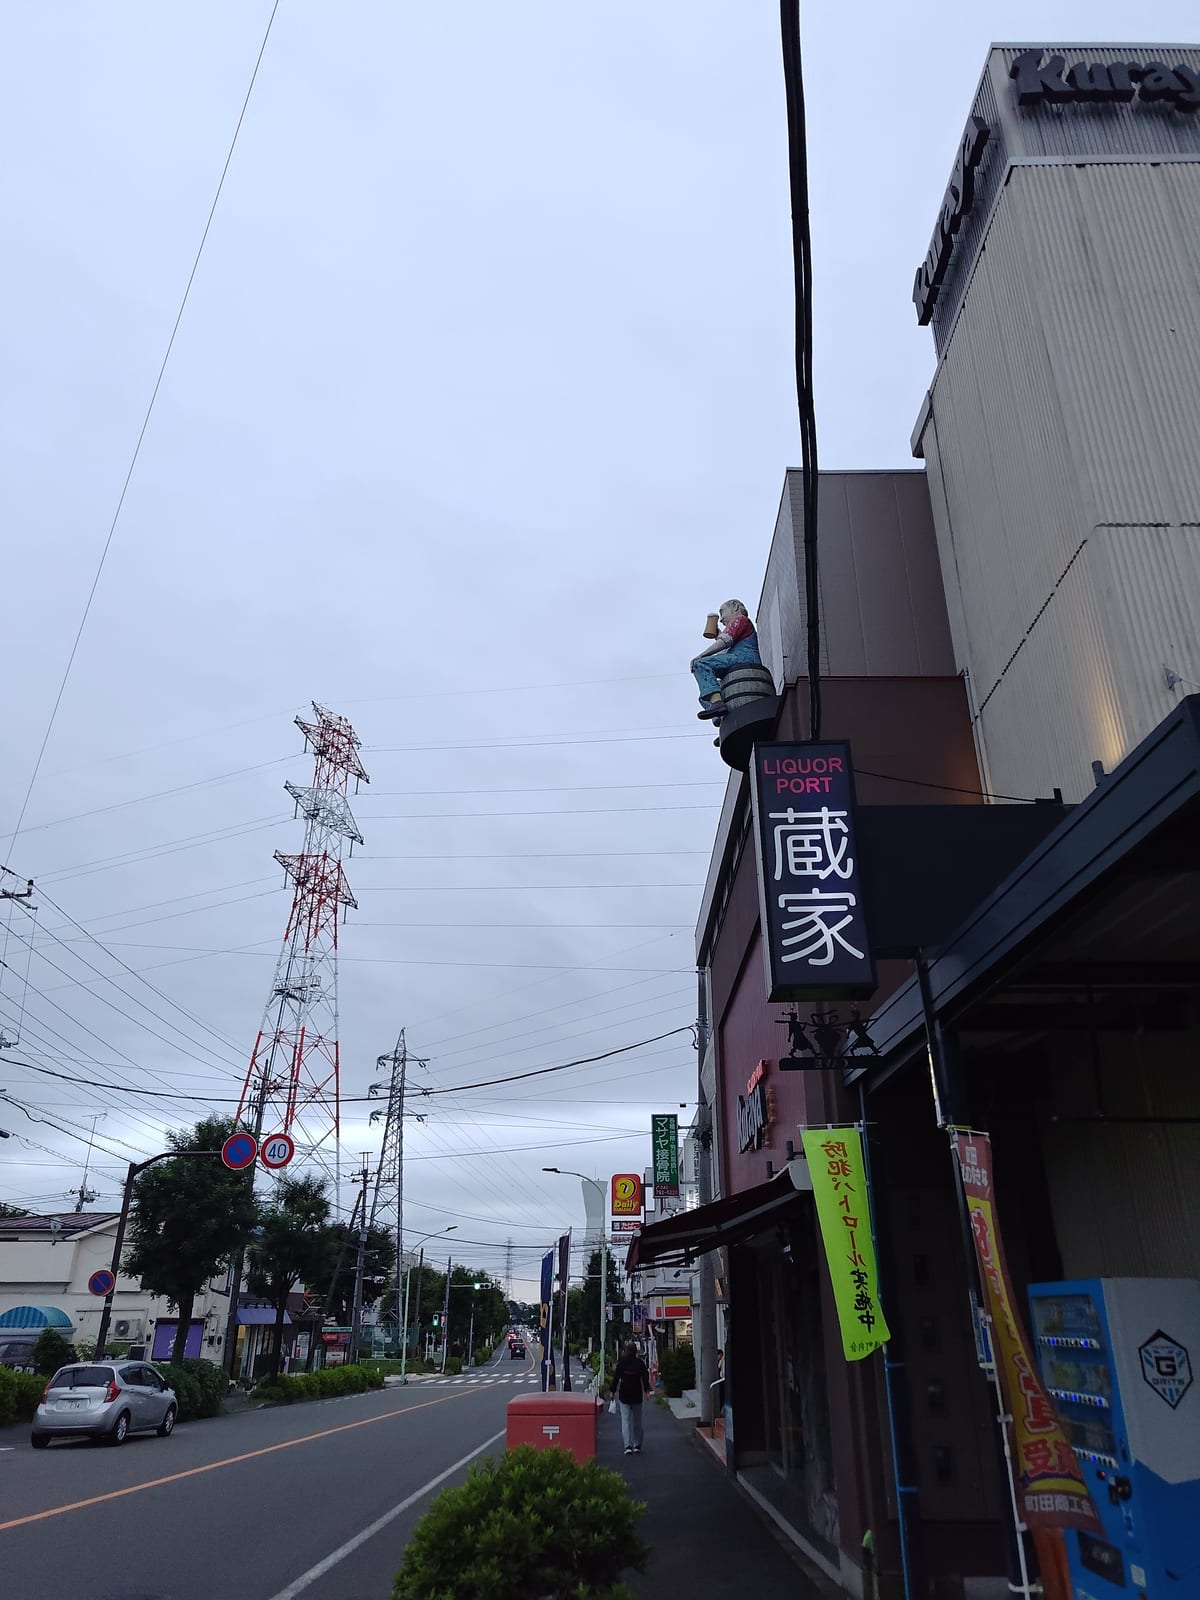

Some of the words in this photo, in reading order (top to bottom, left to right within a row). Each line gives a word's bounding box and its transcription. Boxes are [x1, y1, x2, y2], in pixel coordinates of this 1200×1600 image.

[763, 757, 843, 775] LIQUOR
[776, 777, 832, 793] PORT
[769, 807, 865, 966] 蔵家
[267, 1143, 287, 1159] 40
[655, 1117, 670, 1183] マサヤ接骨院
[614, 1199, 638, 1212] Daily
